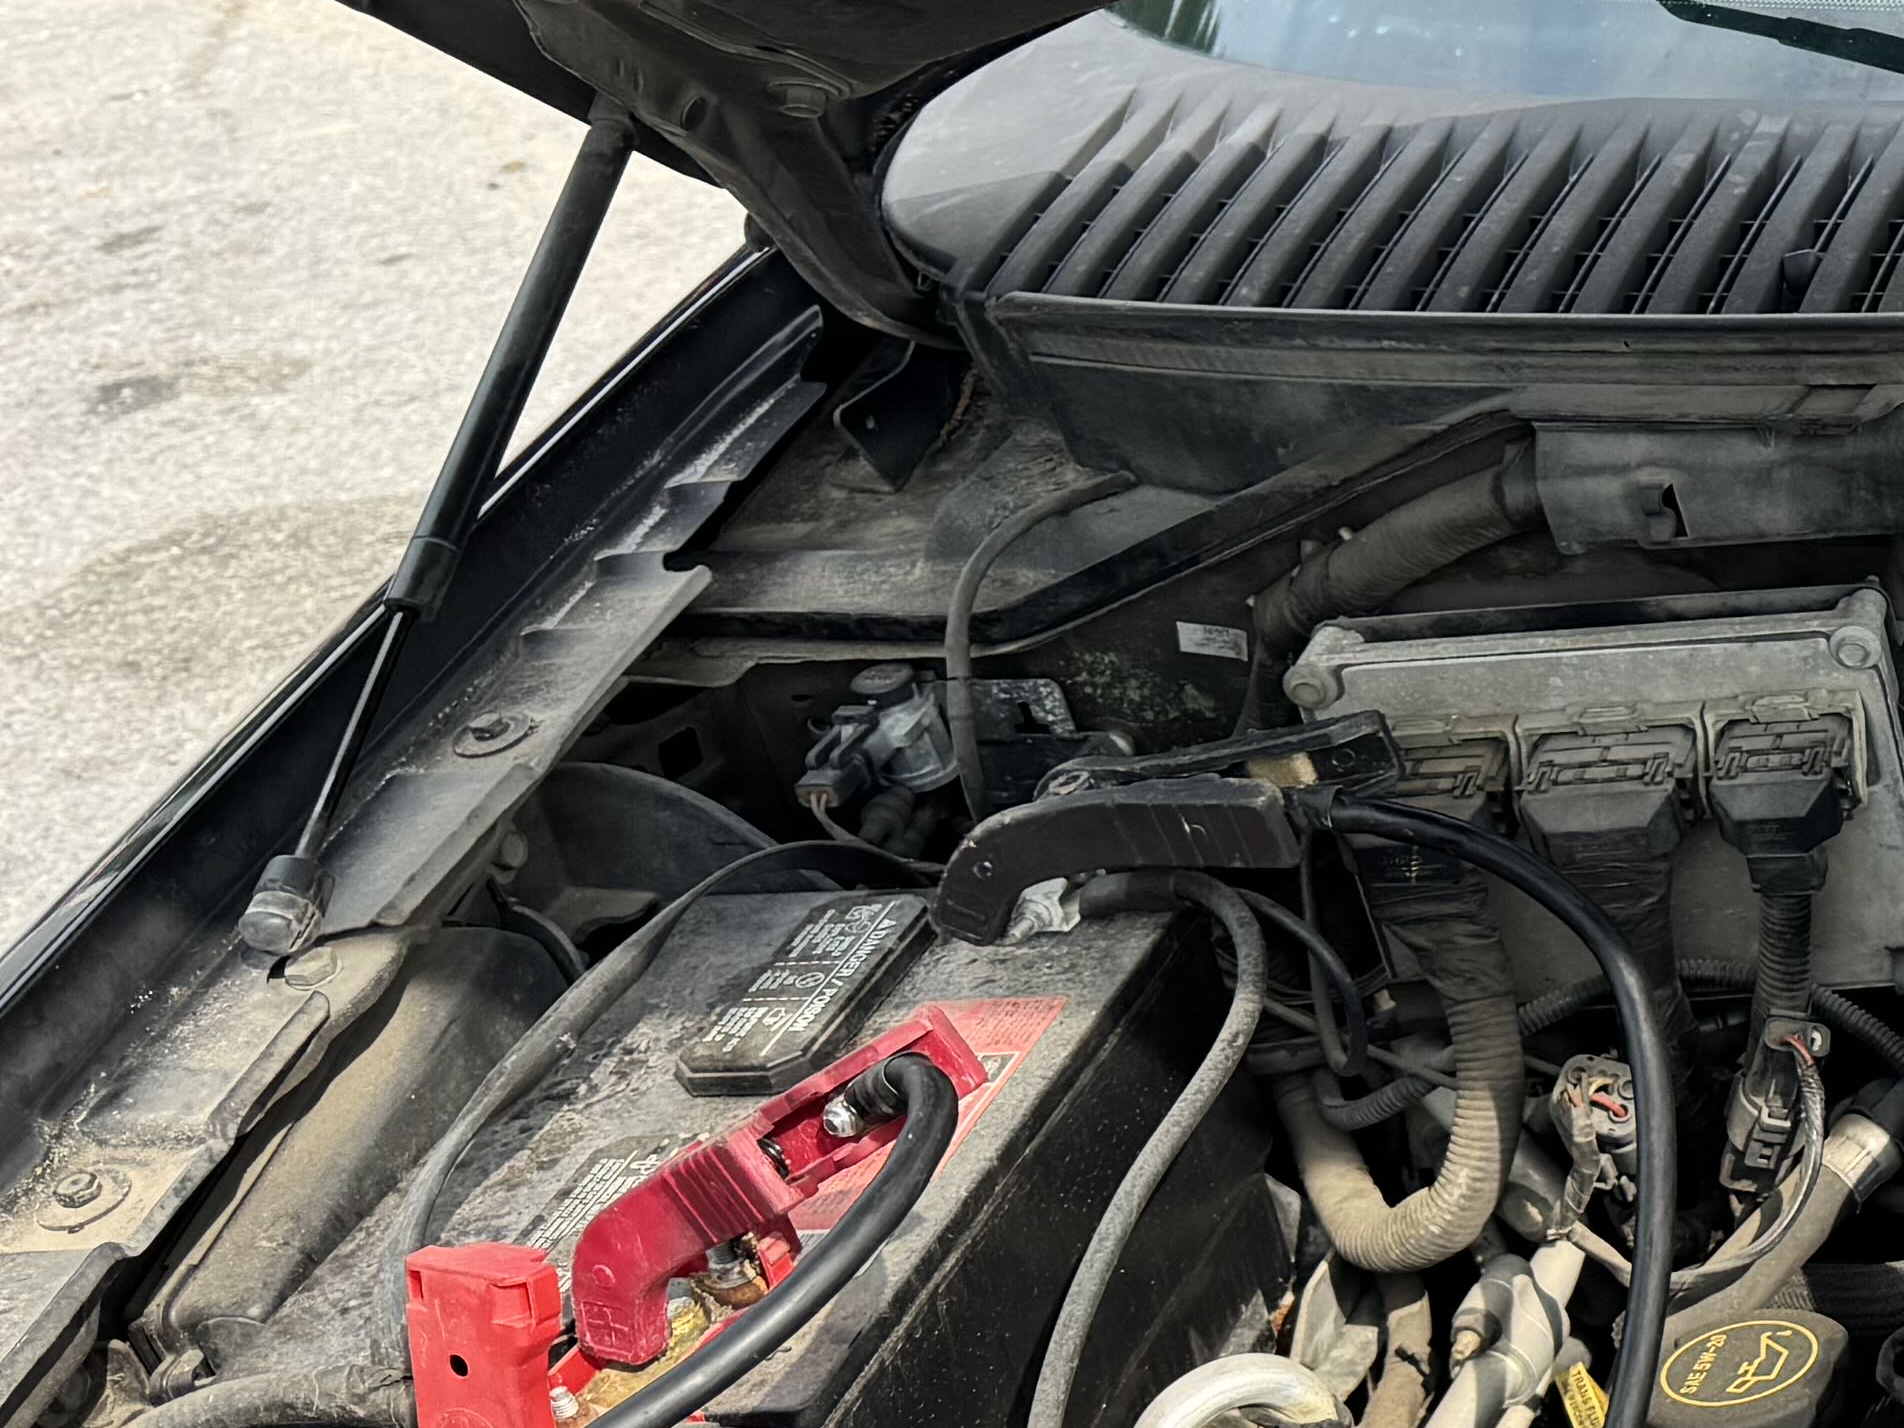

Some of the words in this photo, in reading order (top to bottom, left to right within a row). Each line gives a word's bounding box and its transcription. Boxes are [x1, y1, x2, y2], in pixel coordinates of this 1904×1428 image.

[841, 925, 886, 977] DANGER
[790, 988, 838, 1032] POISON
[1571, 1370, 1593, 1405] TRANS
[1680, 1371, 1709, 1394] SAE
